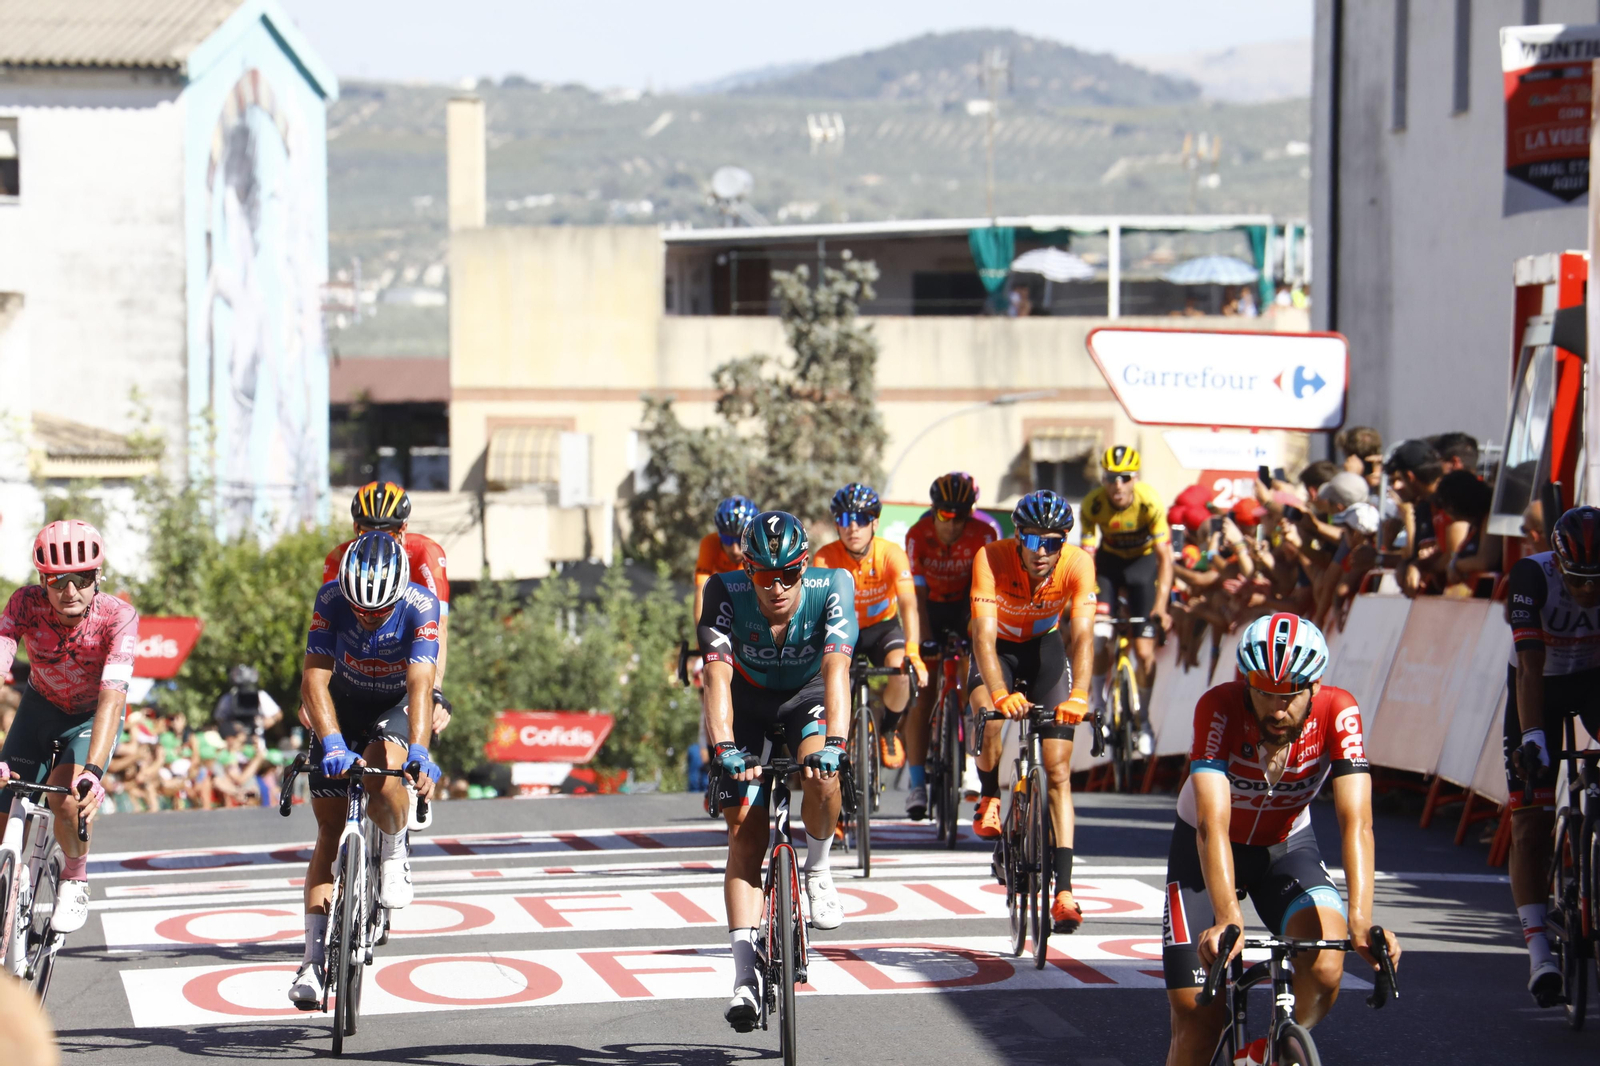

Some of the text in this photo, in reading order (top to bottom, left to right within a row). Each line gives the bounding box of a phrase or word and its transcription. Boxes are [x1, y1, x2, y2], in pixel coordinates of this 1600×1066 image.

[1525, 131, 1547, 151] LA
[1122, 363, 1259, 391] Carrefour
[923, 557, 974, 572] BAHRAIN
[726, 582, 752, 593] BORA
[804, 577, 830, 589] BORA
[855, 582, 888, 598] kaltel
[403, 586, 434, 614] Alpecin
[1513, 593, 1533, 606] FAB
[743, 644, 816, 660] BORA
[350, 661, 403, 673] Alpecin
[519, 725, 595, 748] Cofidis
[1204, 711, 1227, 757] OUDAL
[1228, 774, 1319, 792] SOUDAL
[1300, 893, 1342, 910] dstny
[182, 938, 1274, 1016] COFDIS
